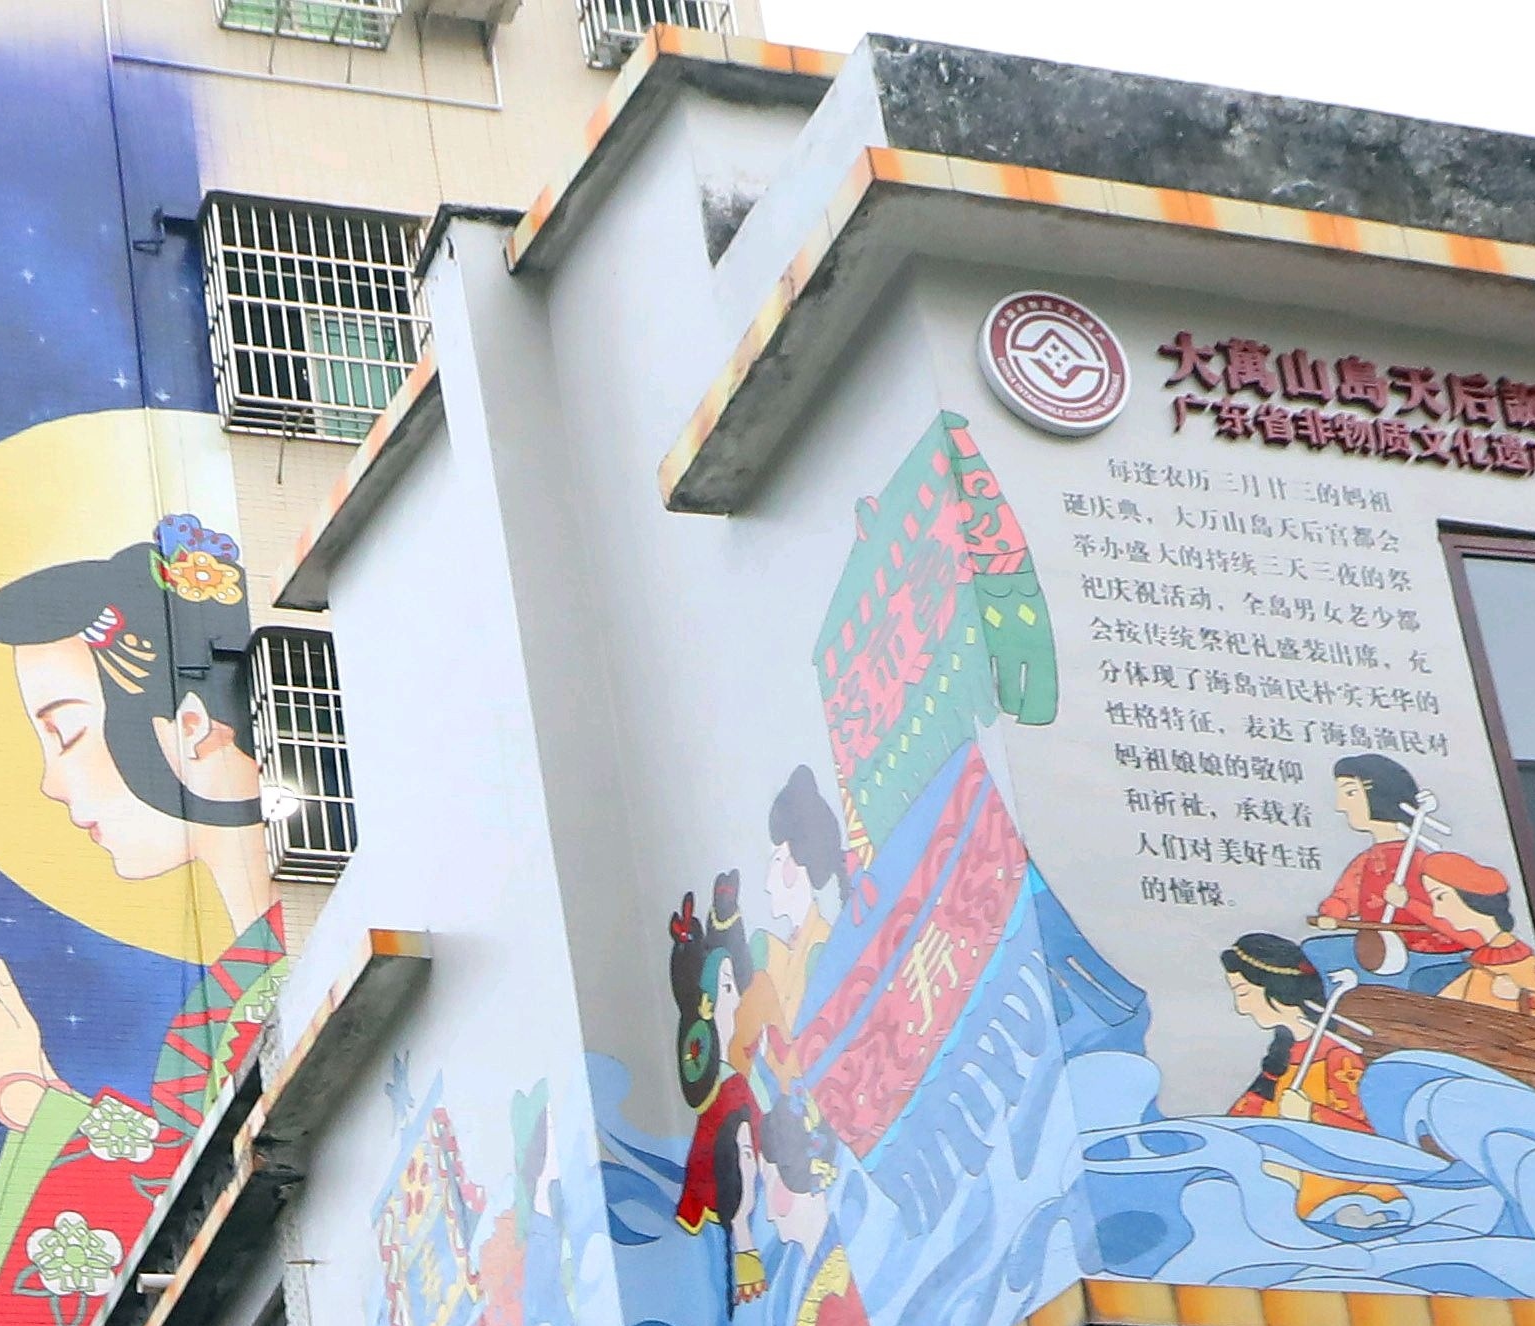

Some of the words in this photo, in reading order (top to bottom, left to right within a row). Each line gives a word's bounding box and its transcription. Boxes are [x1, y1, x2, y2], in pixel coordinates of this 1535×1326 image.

[1135, 832, 1322, 871] 人们对美好生活
